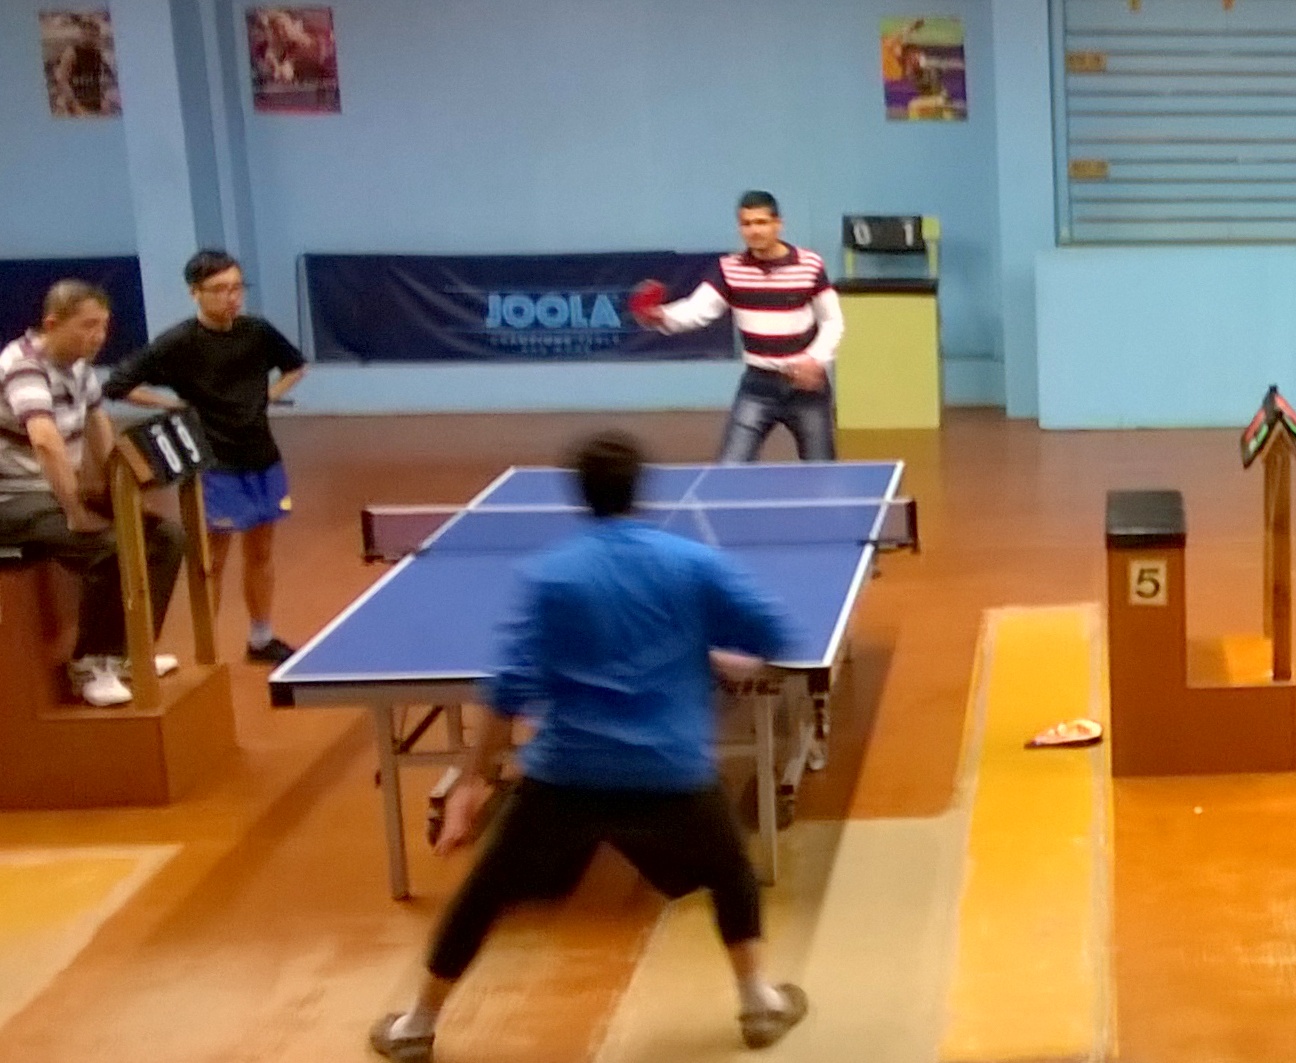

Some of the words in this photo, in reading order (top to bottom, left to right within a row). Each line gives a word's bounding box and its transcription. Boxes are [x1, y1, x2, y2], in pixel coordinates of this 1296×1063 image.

[853, 219, 872, 246] 0
[903, 220, 914, 246] 1
[486, 294, 621, 328] JOOLA
[1136, 568, 1160, 598] 5
